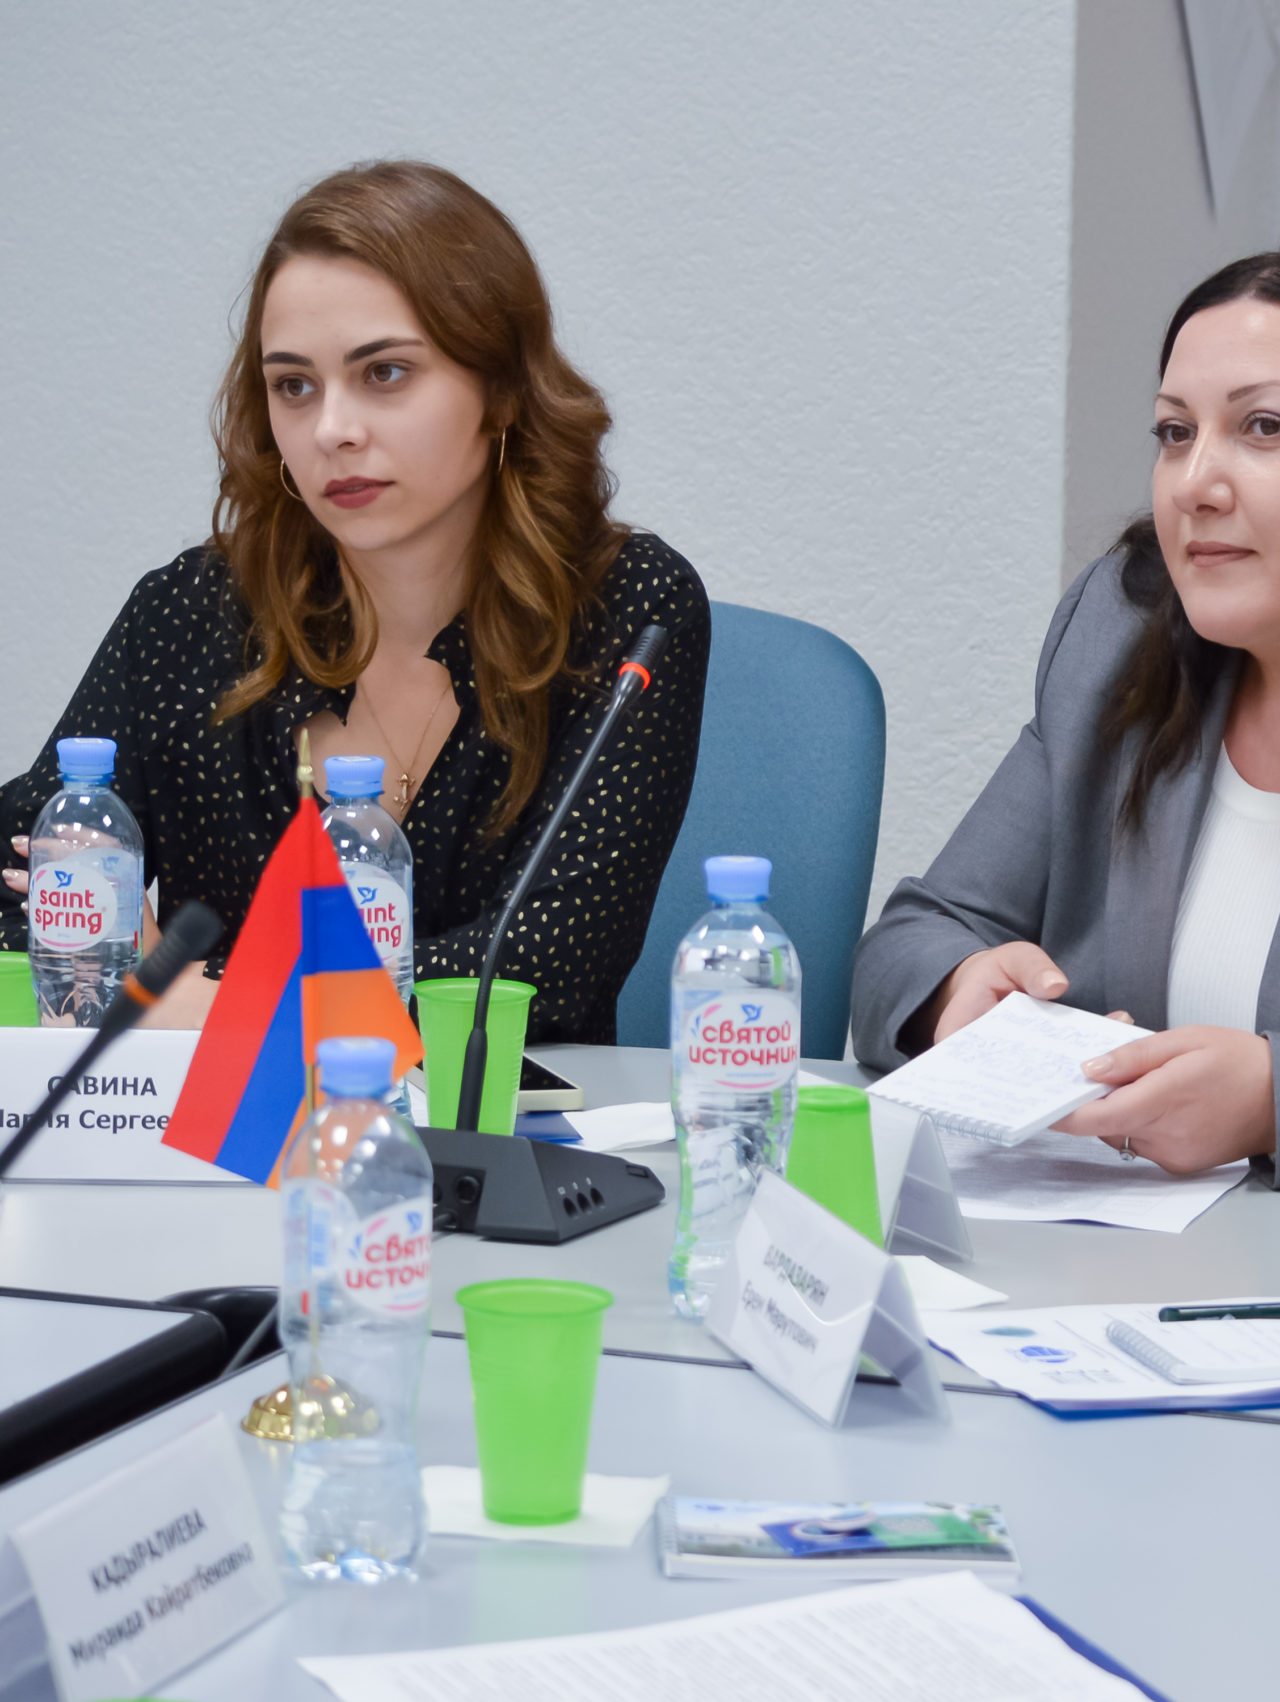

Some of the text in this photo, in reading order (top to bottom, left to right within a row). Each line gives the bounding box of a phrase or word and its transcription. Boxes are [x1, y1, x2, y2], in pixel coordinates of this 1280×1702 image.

[40, 889, 95, 908] saint
[35, 908, 102, 935] spring
[358, 903, 396, 923] int
[79, 1110, 171, 1134] Сергее
